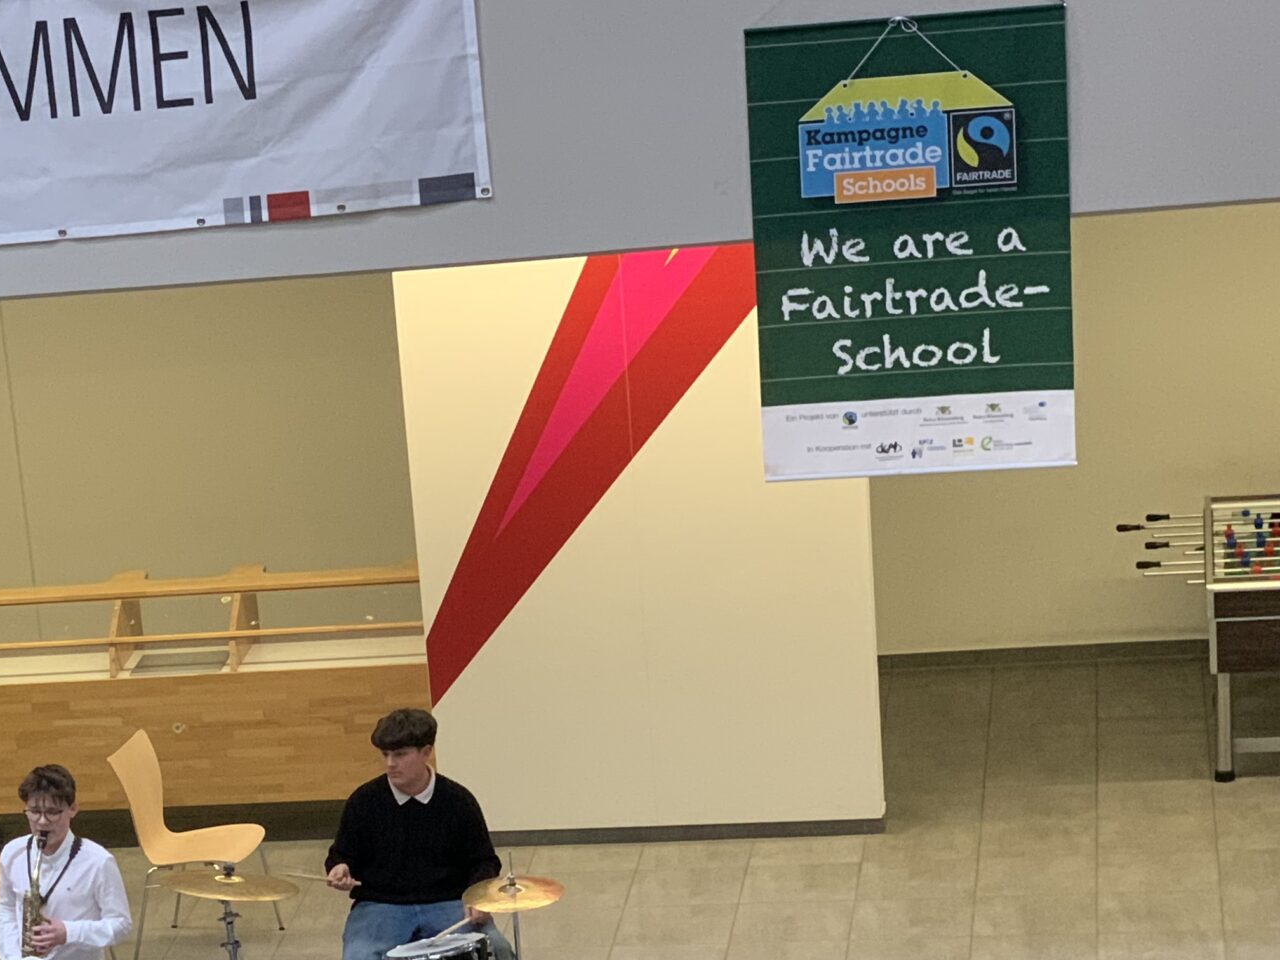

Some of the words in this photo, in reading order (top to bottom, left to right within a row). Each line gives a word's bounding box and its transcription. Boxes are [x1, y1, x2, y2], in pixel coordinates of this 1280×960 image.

[805, 123, 928, 147] Kampagne
[806, 142, 942, 172] Fairtrade
[842, 174, 926, 195] Schools
[956, 168, 1012, 181] FAIRTRADE
[800, 227, 870, 267] We
[893, 231, 974, 259] are
[997, 227, 1027, 252] a
[781, 269, 1050, 321] Fairtrade-
[832, 327, 1001, 376] School
